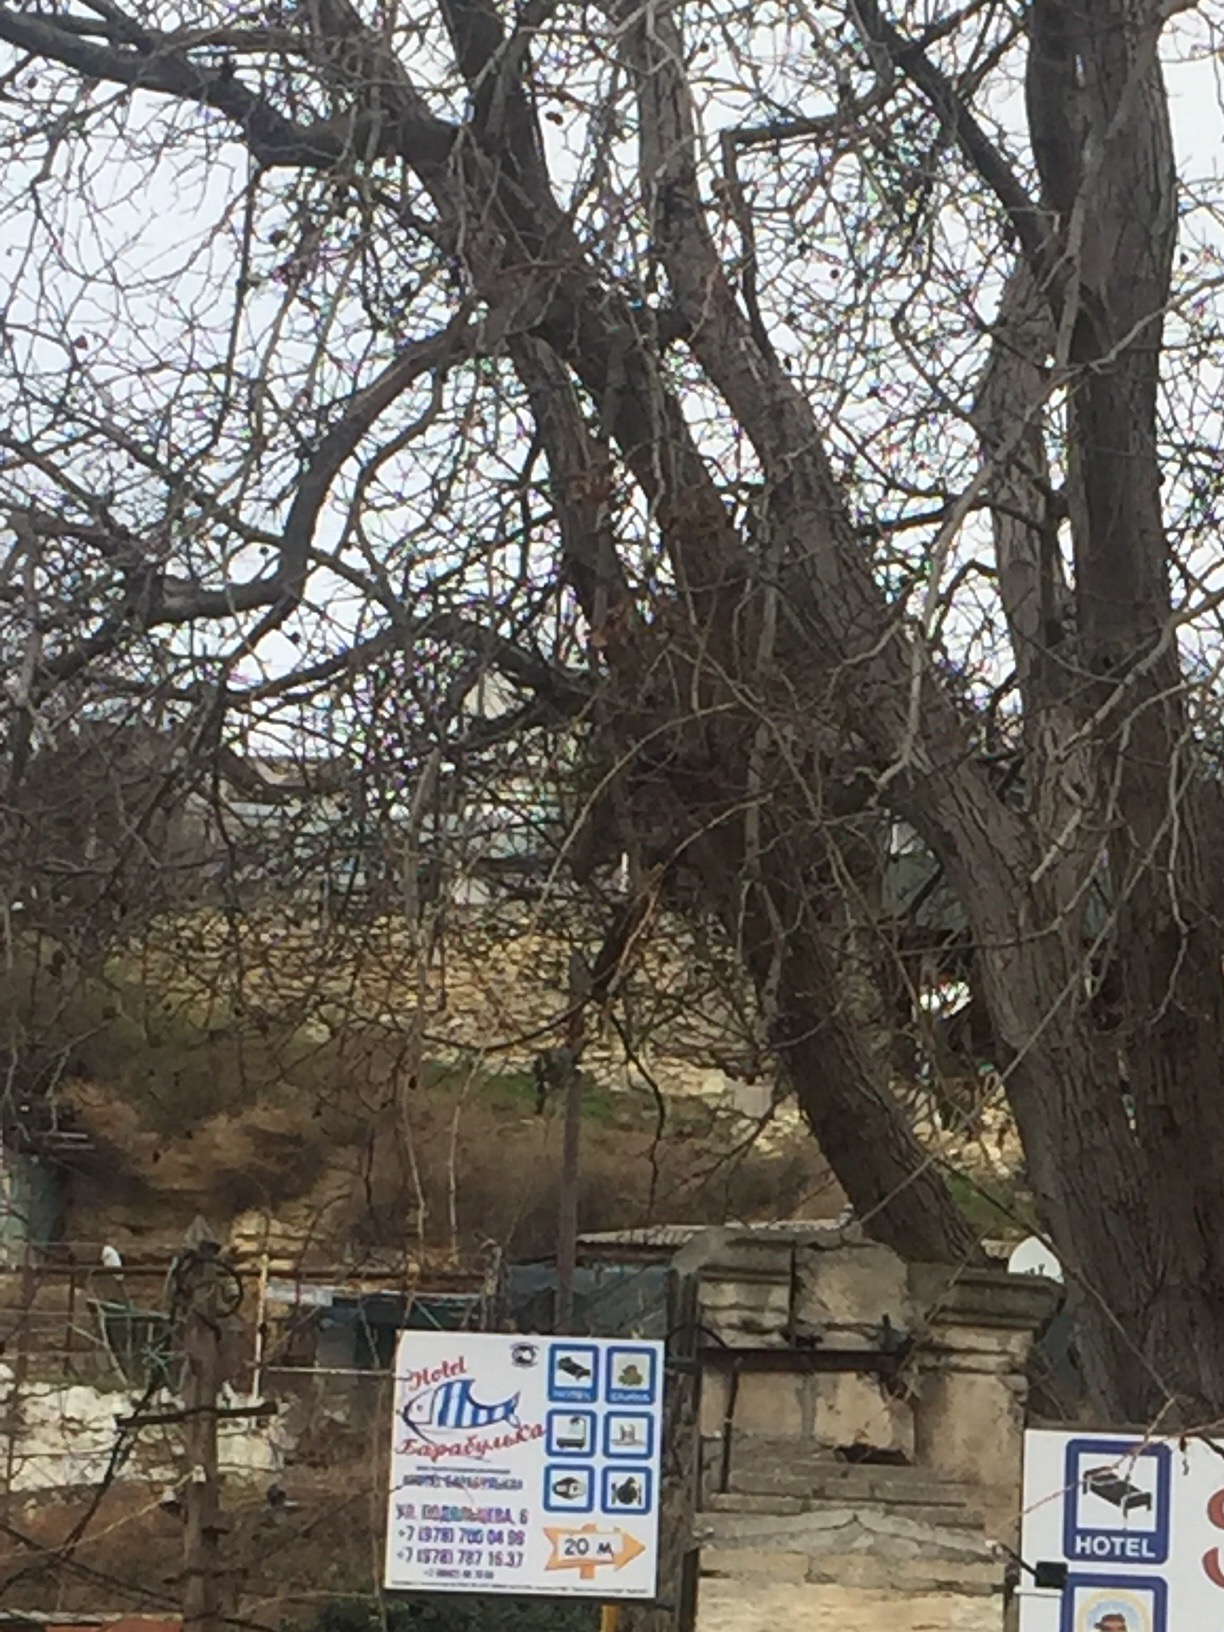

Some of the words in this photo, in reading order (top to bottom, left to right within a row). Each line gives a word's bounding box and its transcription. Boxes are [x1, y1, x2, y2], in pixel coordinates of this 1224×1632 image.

[408, 1356, 466, 1390] Hotel
[396, 1423, 546, 1462] Барабулька
[564, 1537, 589, 1556] 20
[1074, 1535, 1156, 1558] HOTEL
